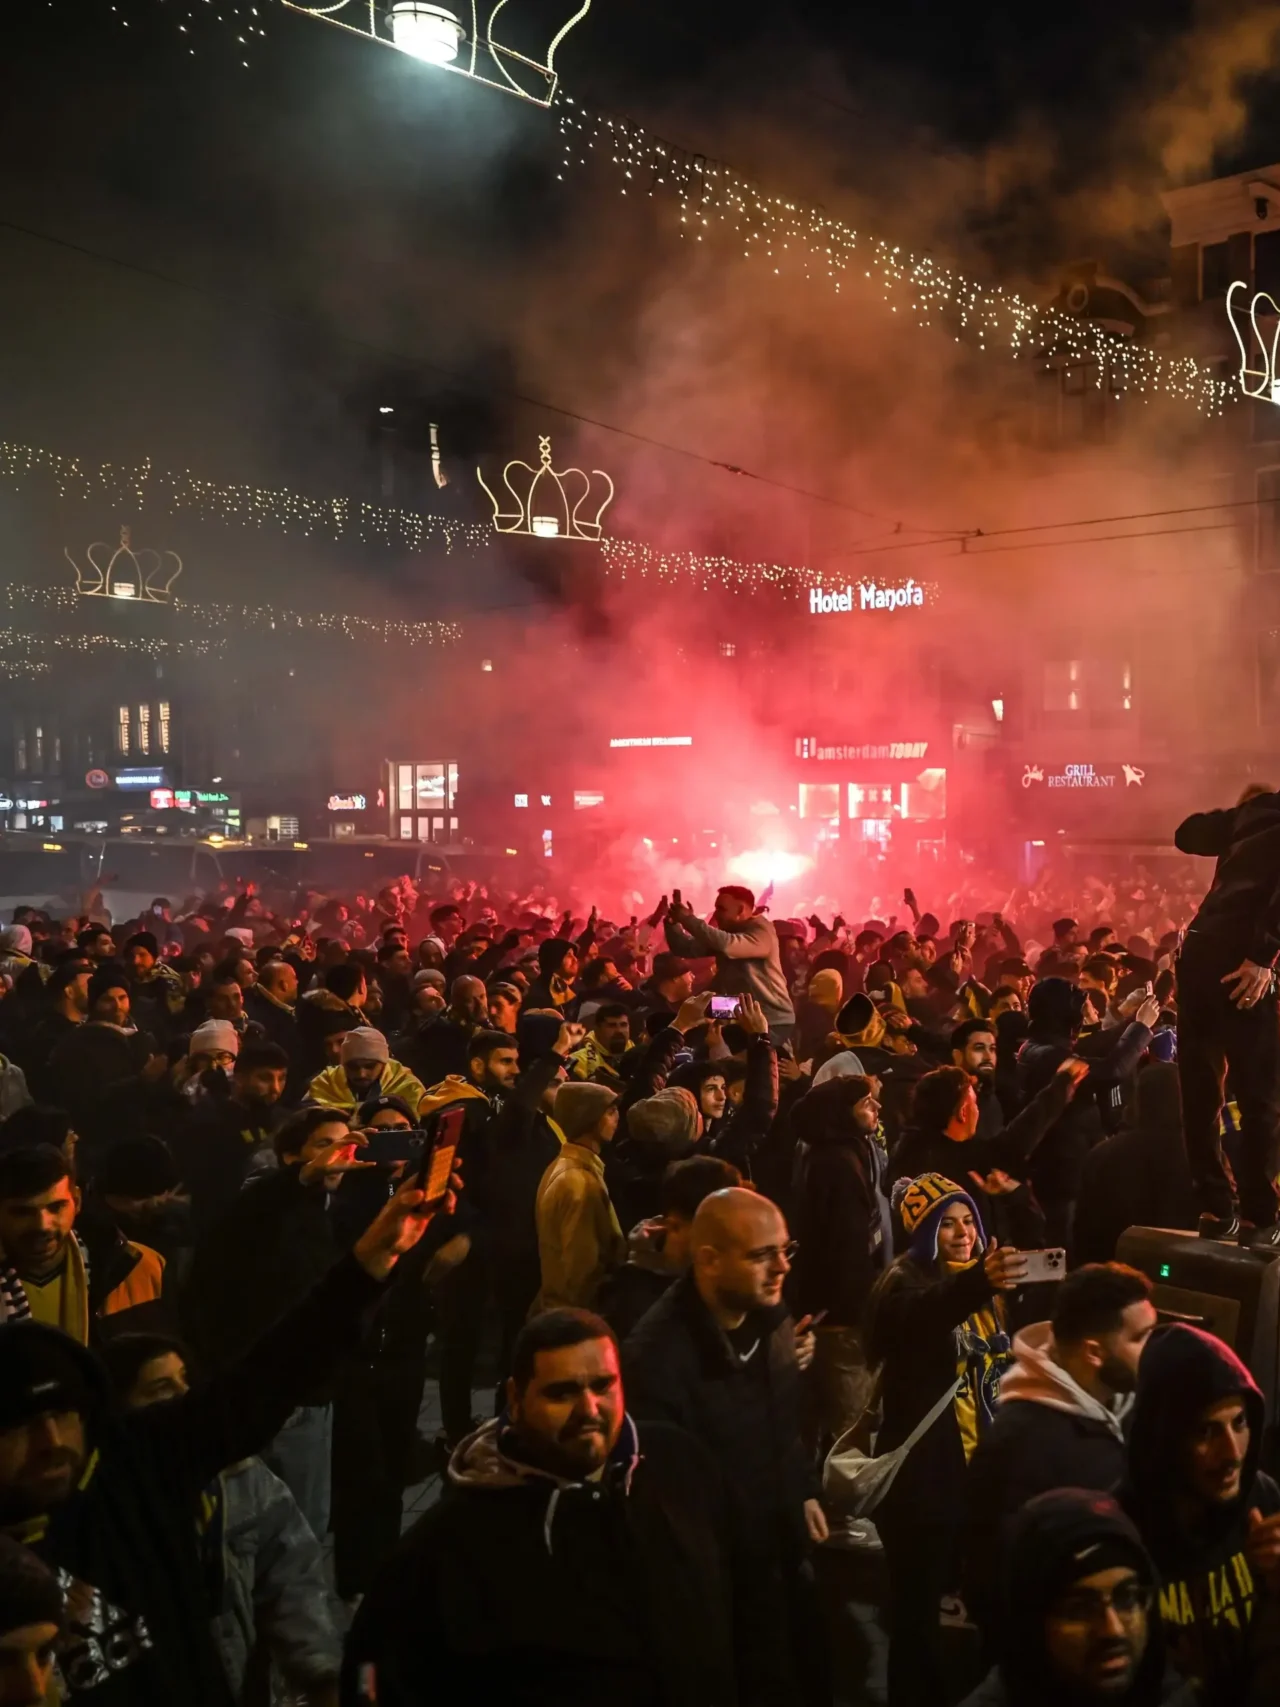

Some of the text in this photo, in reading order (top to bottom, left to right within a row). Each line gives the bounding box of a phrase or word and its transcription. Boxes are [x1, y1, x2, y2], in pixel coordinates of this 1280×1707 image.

[809, 579, 924, 614] Hotel Manofa
[1064, 764, 1096, 777] GRILL
[1047, 775, 1116, 788] RESTAURANT
